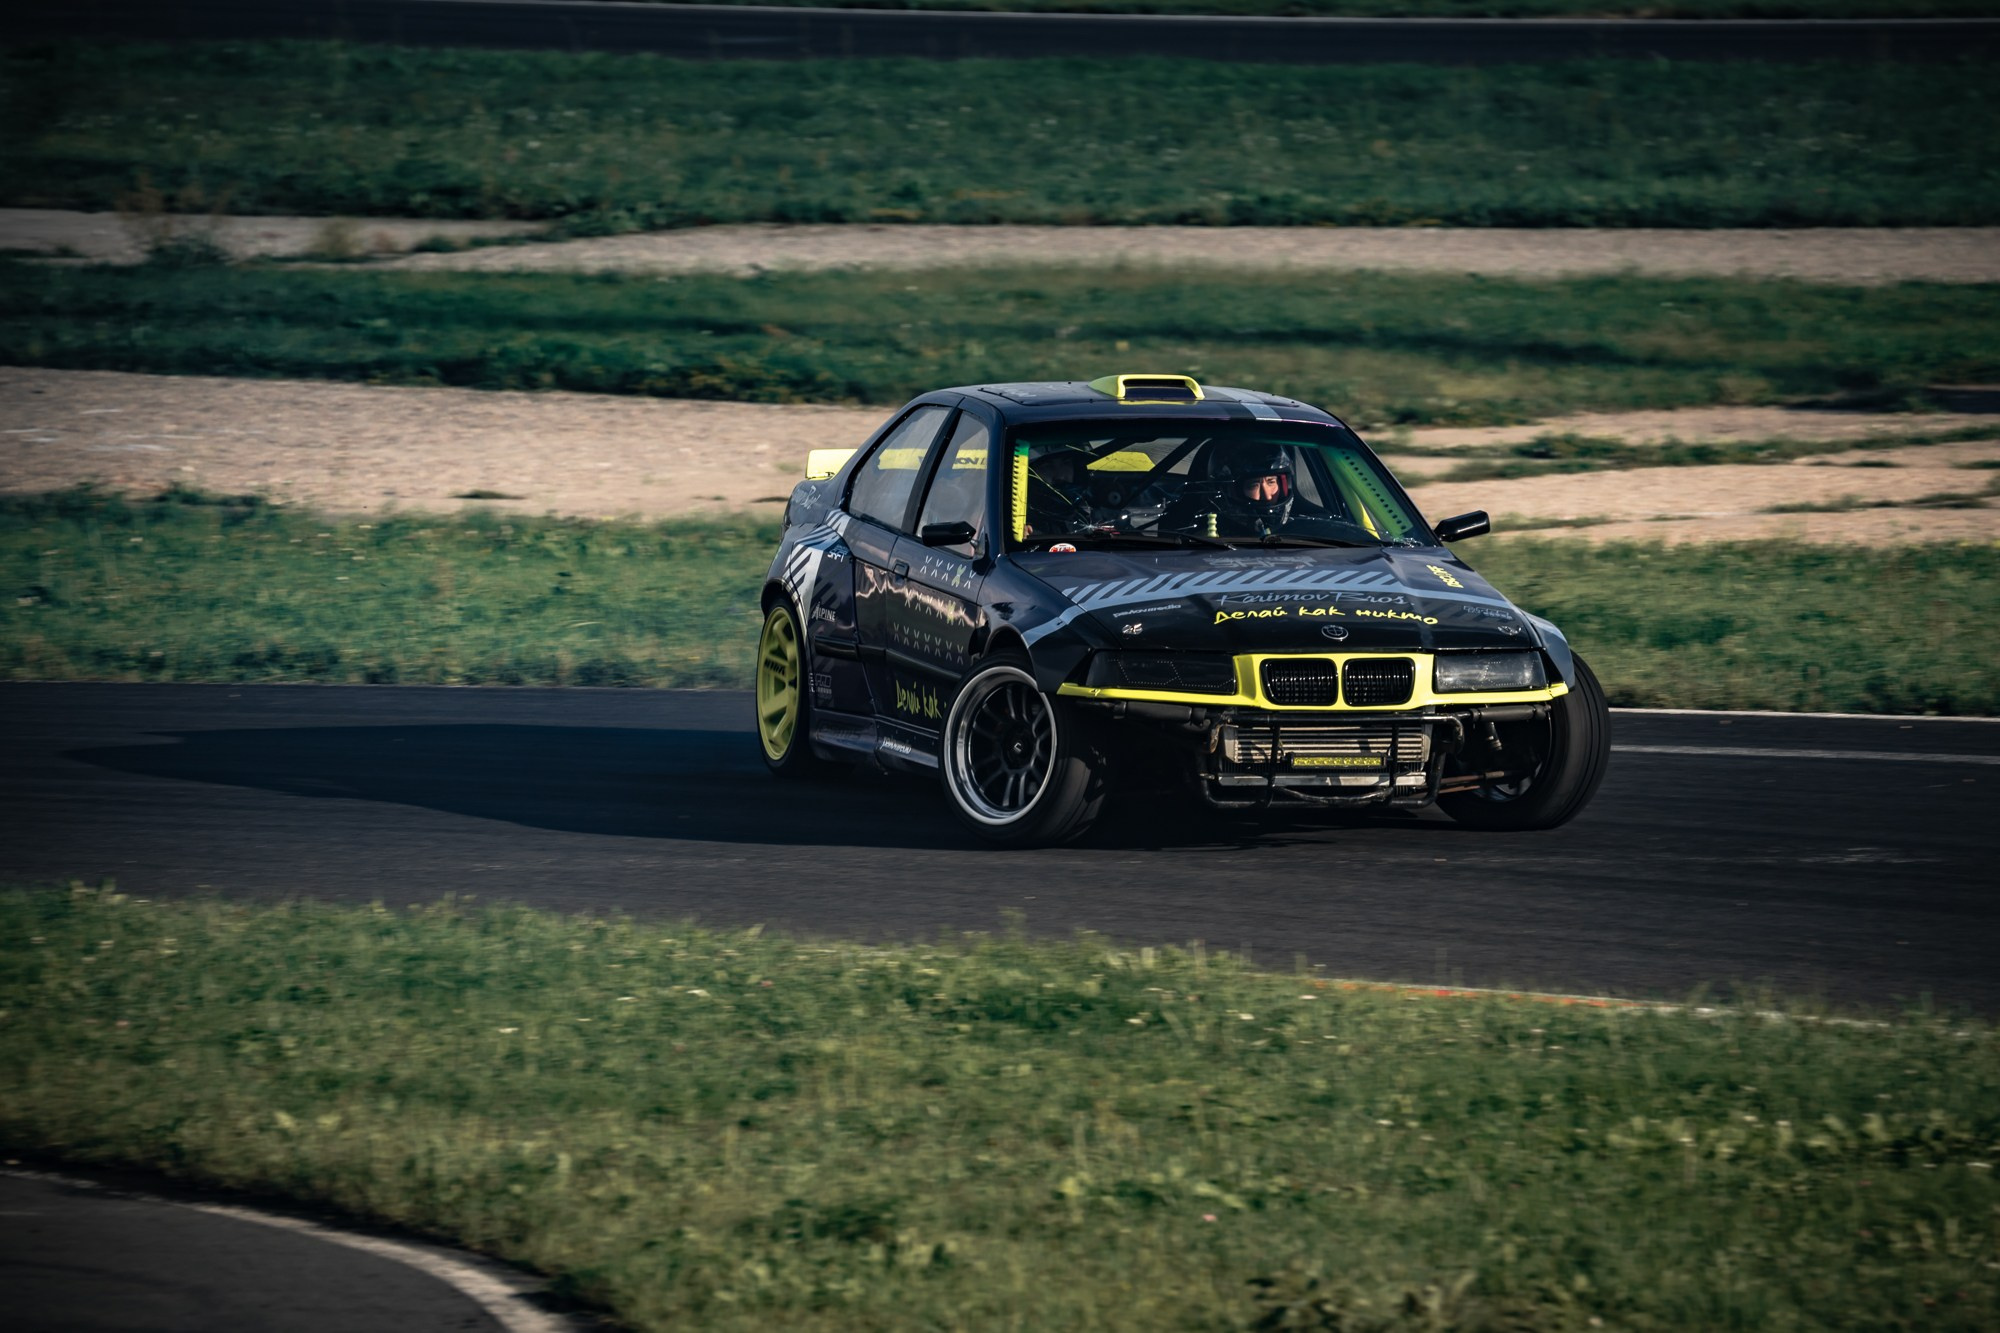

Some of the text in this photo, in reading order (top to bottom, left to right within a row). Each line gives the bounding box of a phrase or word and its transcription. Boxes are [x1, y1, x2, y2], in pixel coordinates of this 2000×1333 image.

[1216, 591, 1328, 606] Karimov
[1298, 605, 1346, 617] как
[1355, 609, 1439, 625] никто
